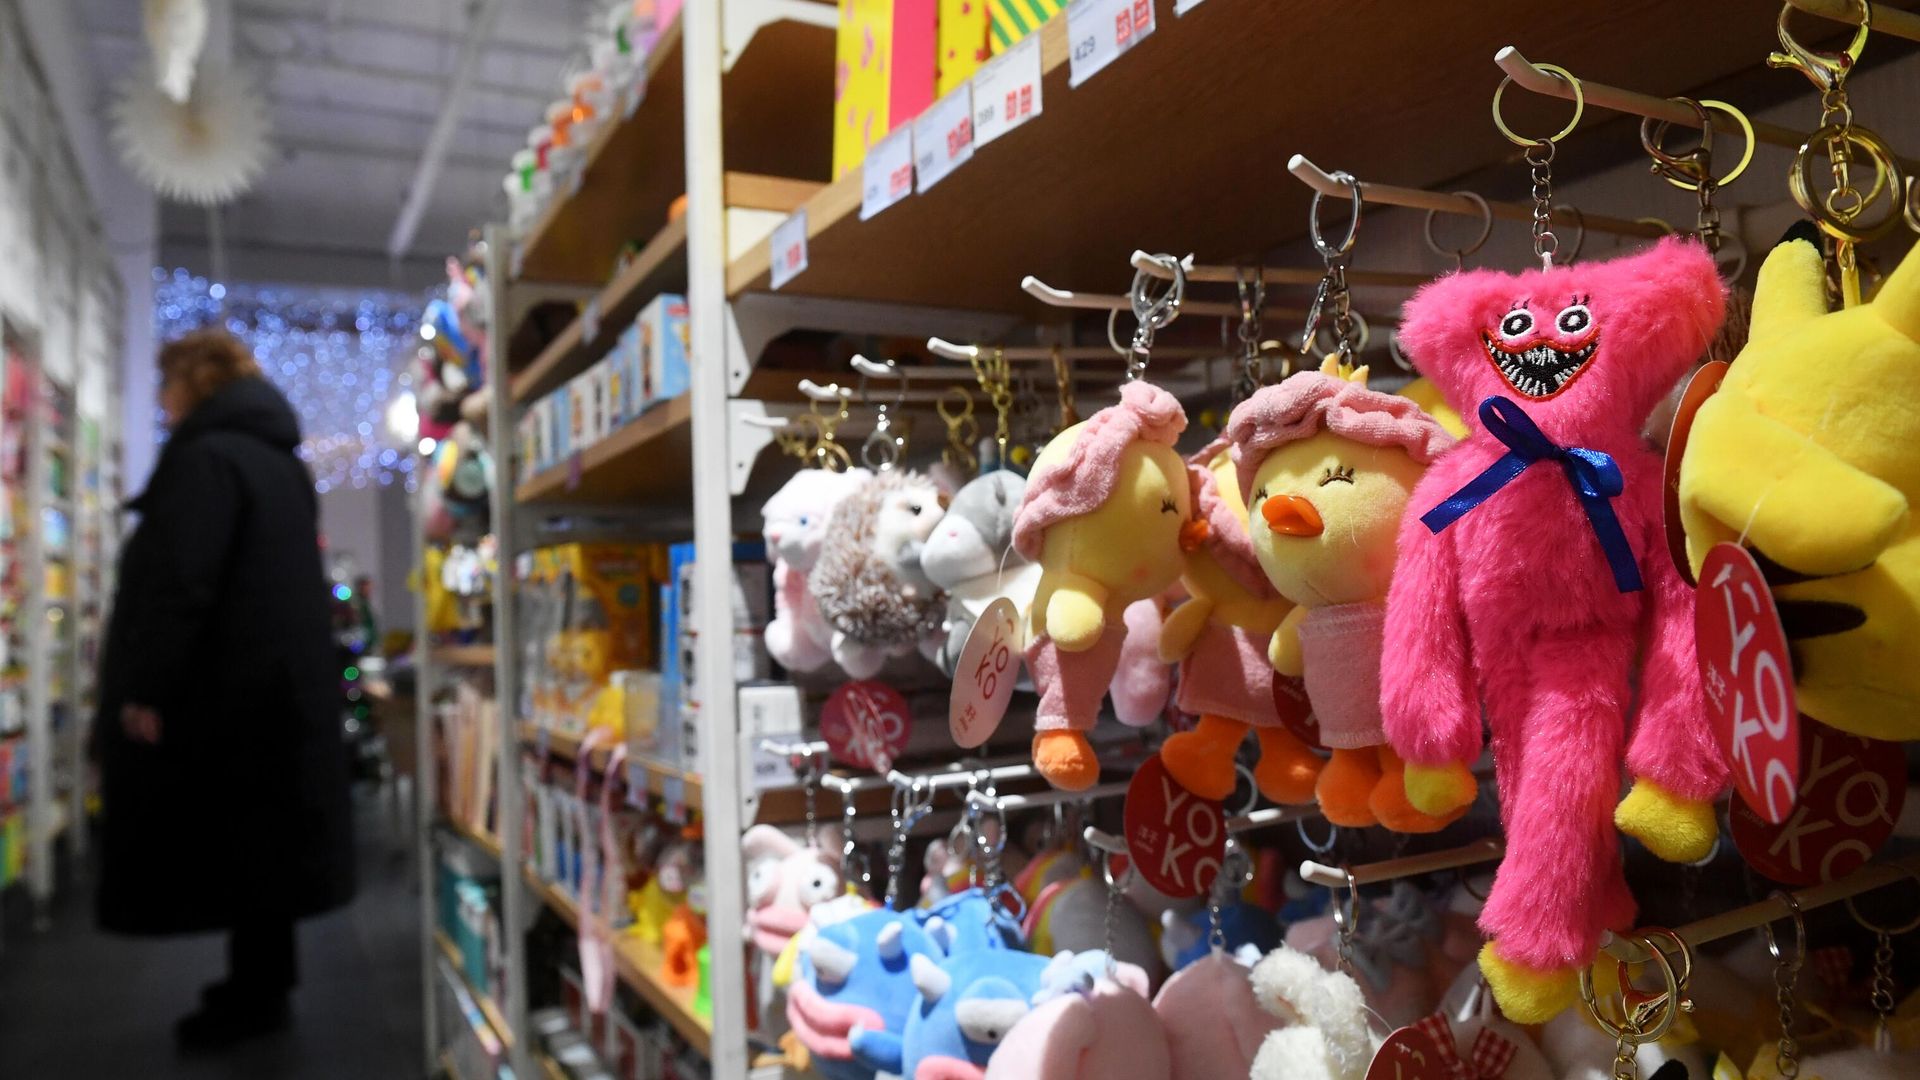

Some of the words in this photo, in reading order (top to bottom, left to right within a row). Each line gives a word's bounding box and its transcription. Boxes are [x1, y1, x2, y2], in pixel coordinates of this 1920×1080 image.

[974, 654, 997, 700] KO
[989, 625, 1009, 672] YO
[1724, 584, 1788, 741] YO
[1161, 775, 1217, 848] YO
[1799, 735, 1889, 827] YO
